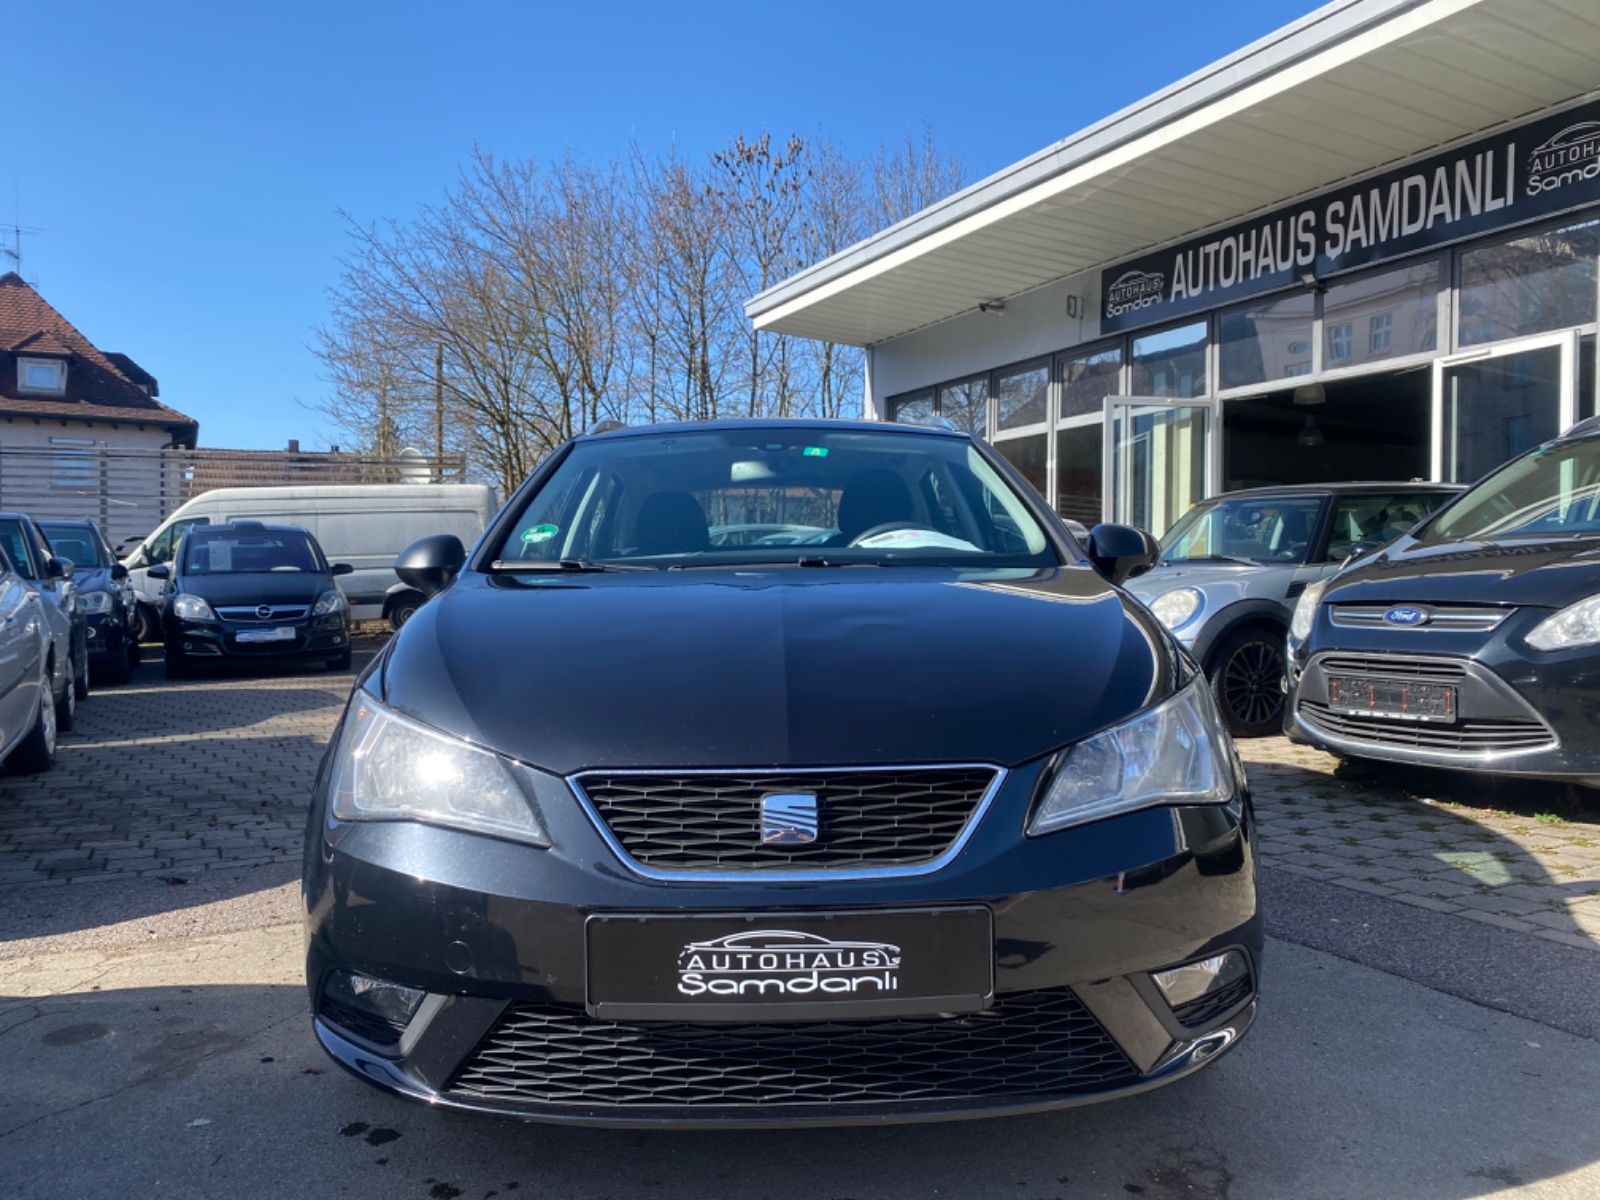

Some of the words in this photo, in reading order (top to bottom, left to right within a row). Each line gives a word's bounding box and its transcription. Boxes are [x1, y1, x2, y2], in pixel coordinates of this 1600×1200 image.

[1170, 210, 1316, 303] AUTOHAUS
[1109, 278, 1160, 302] AUTOHAUS
[1390, 610, 1417, 621] Ford
[687, 951, 880, 970] AUTOHAUS
